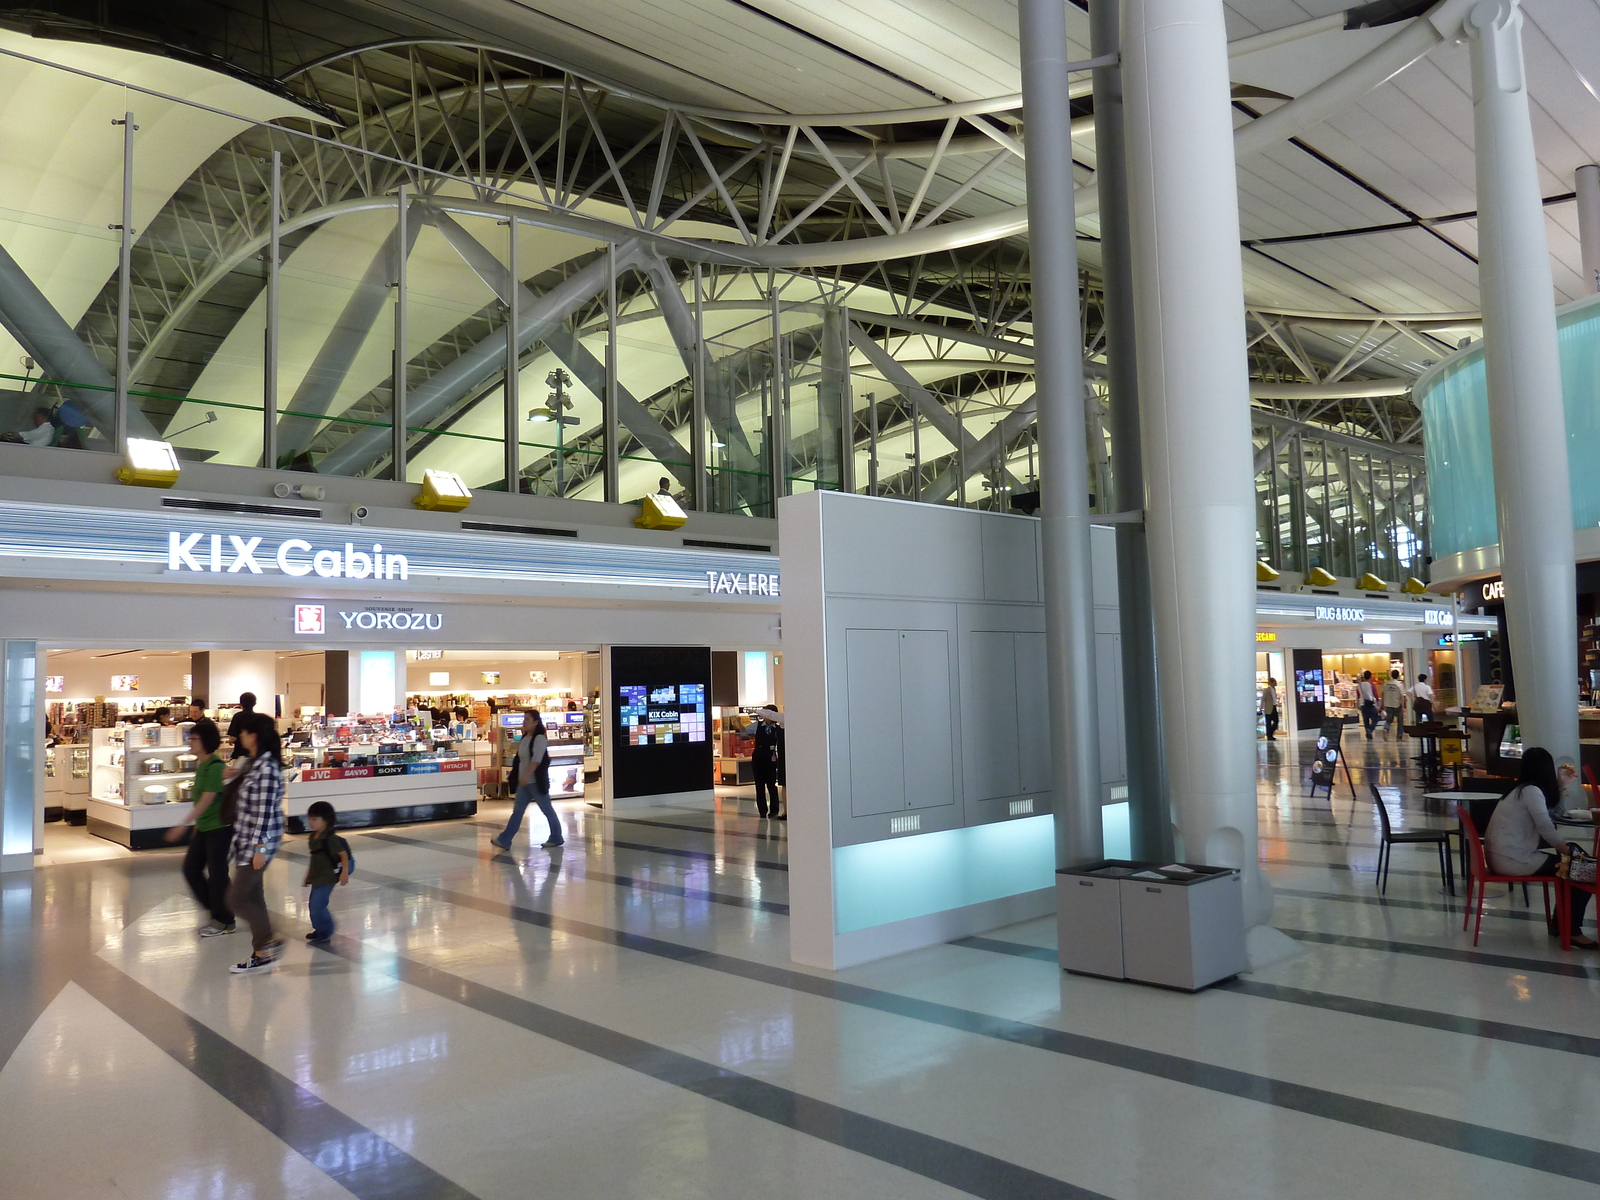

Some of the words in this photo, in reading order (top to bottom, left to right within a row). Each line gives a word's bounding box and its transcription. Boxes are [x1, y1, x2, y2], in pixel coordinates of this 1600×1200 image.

[168, 531, 263, 574] KIX
[276, 538, 409, 580] Cabin
[706, 571, 742, 595] TAX
[748, 573, 779, 596] FRE
[338, 611, 443, 631] YOROZU
[1315, 606, 1335, 620] DRUG
[1336, 607, 1341, 620] &
[1342, 608, 1364, 621] BOOKS
[1425, 610, 1438, 625] KIX
[1439, 610, 1453, 625] Cab
[660, 710, 679, 718] Cabin
[310, 770, 331, 780] JVC
